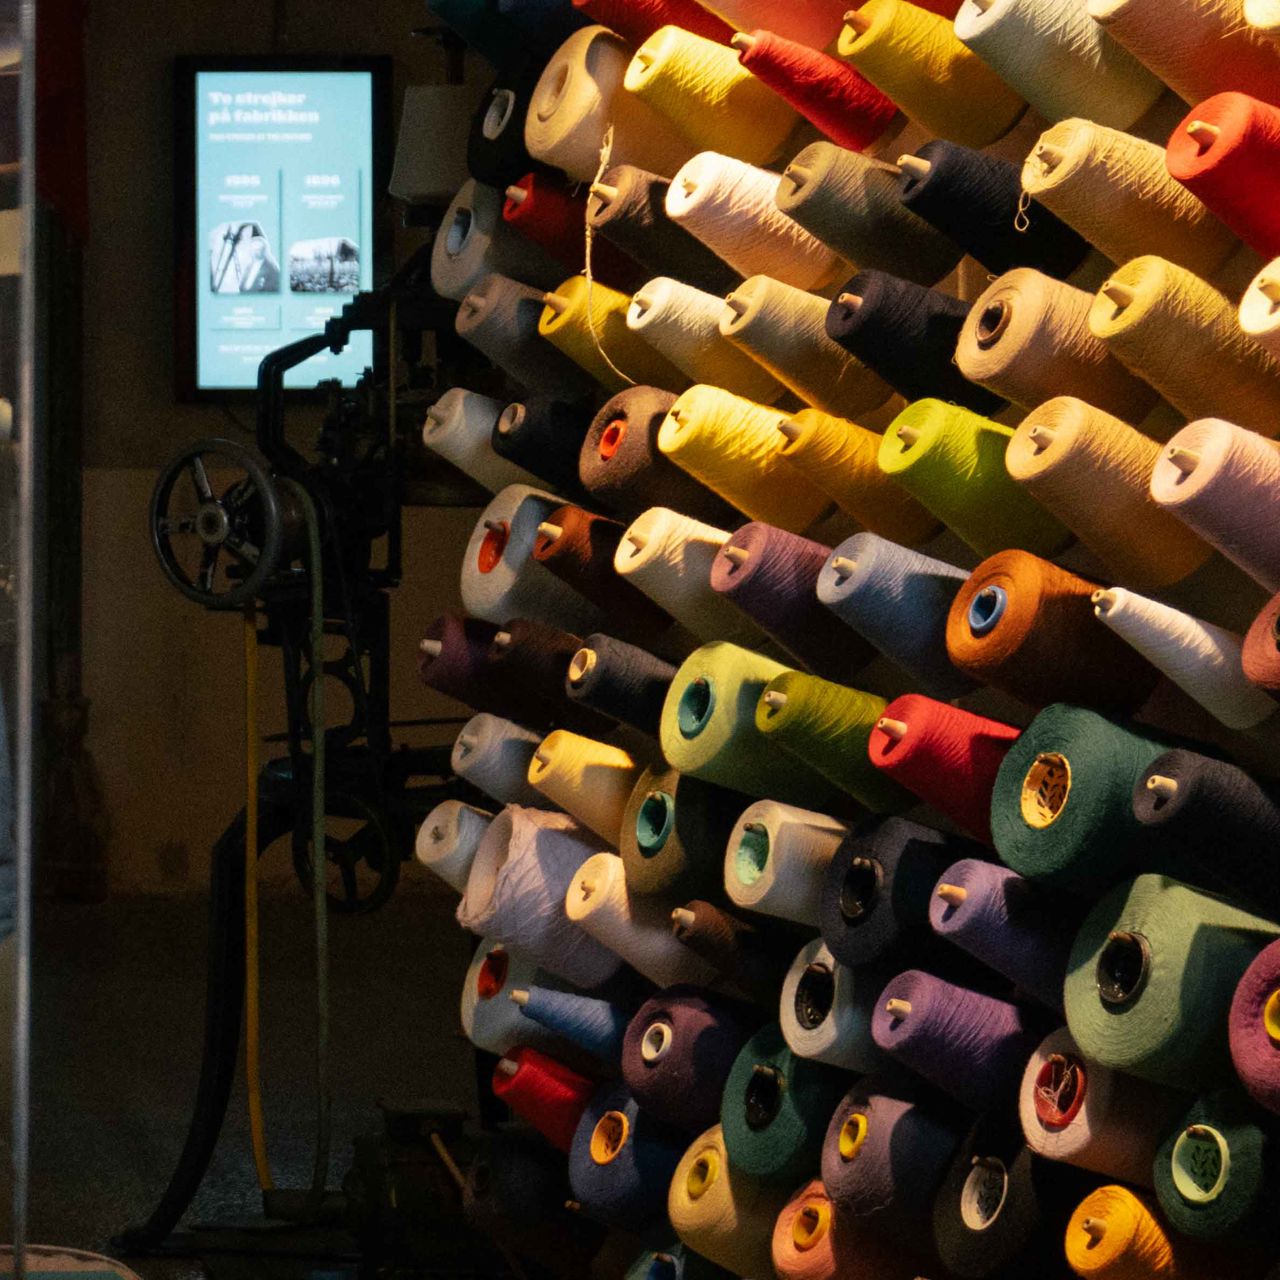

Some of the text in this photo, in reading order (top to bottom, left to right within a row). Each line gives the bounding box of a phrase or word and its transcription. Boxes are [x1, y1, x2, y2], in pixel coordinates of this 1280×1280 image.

[208, 91, 307, 108] To strejker
[207, 107, 320, 126] på fabrikken
